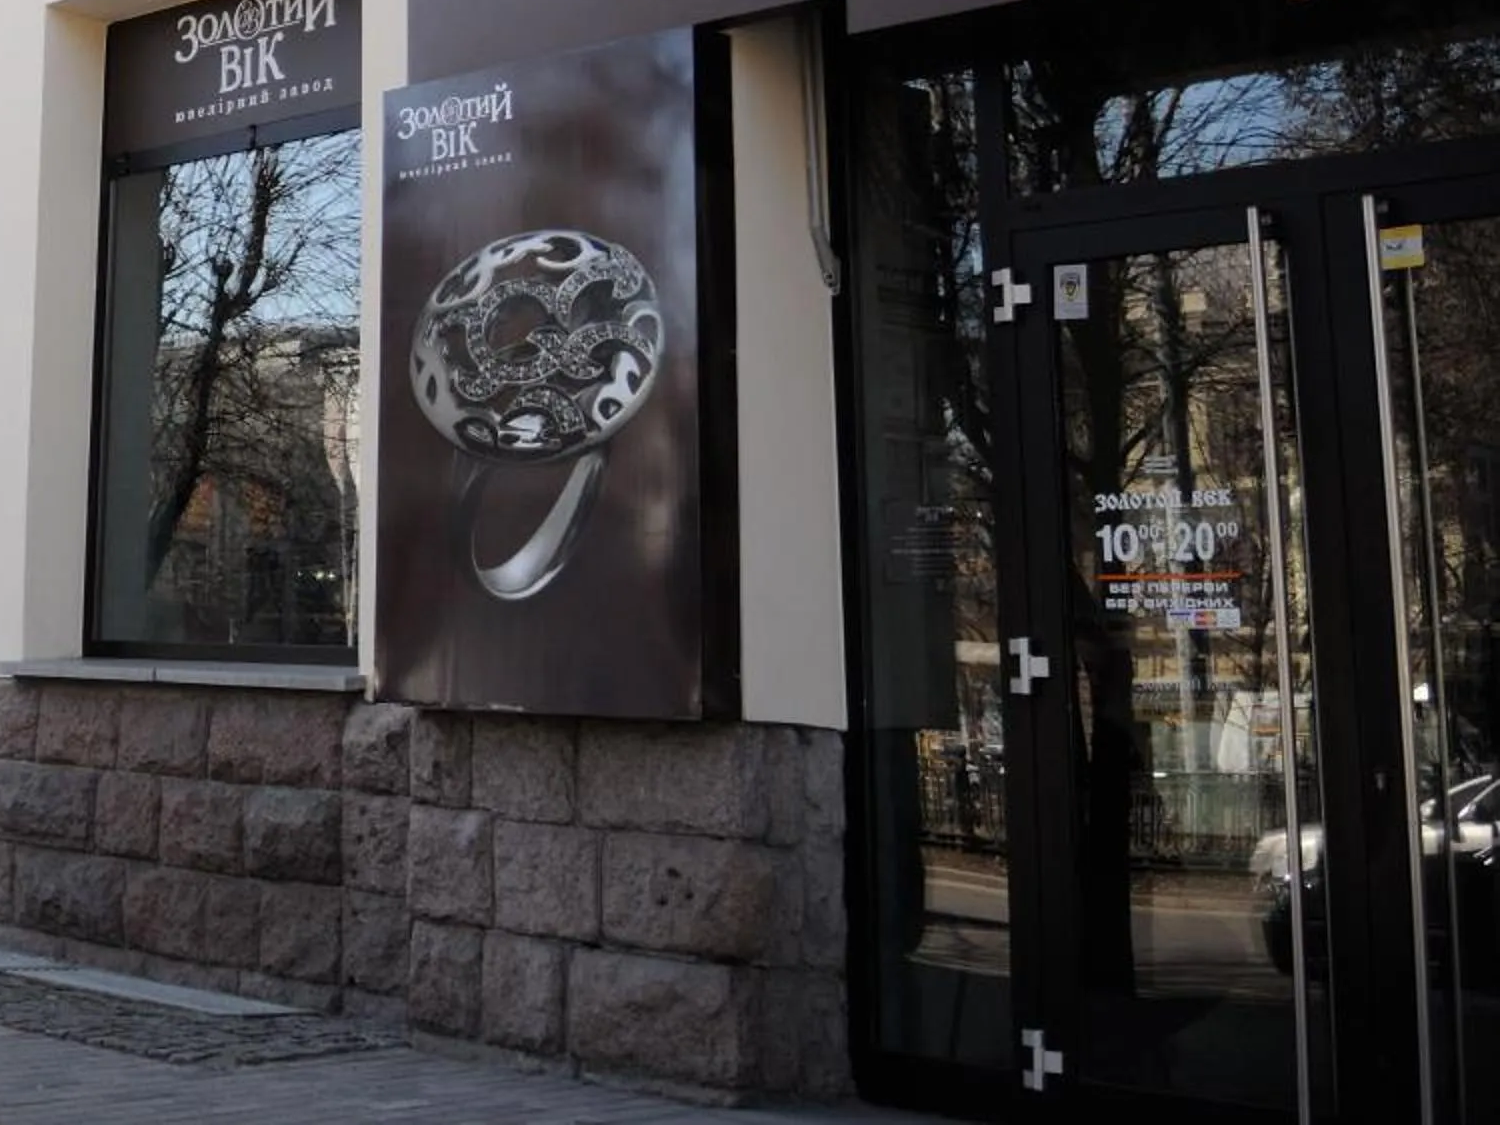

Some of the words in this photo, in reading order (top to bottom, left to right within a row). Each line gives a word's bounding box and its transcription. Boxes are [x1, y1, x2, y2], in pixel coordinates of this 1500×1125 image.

[219, 31, 285, 94] ВІК
[397, 82, 513, 139] ЗОЛОТИЙ
[432, 121, 480, 161] ВІК
